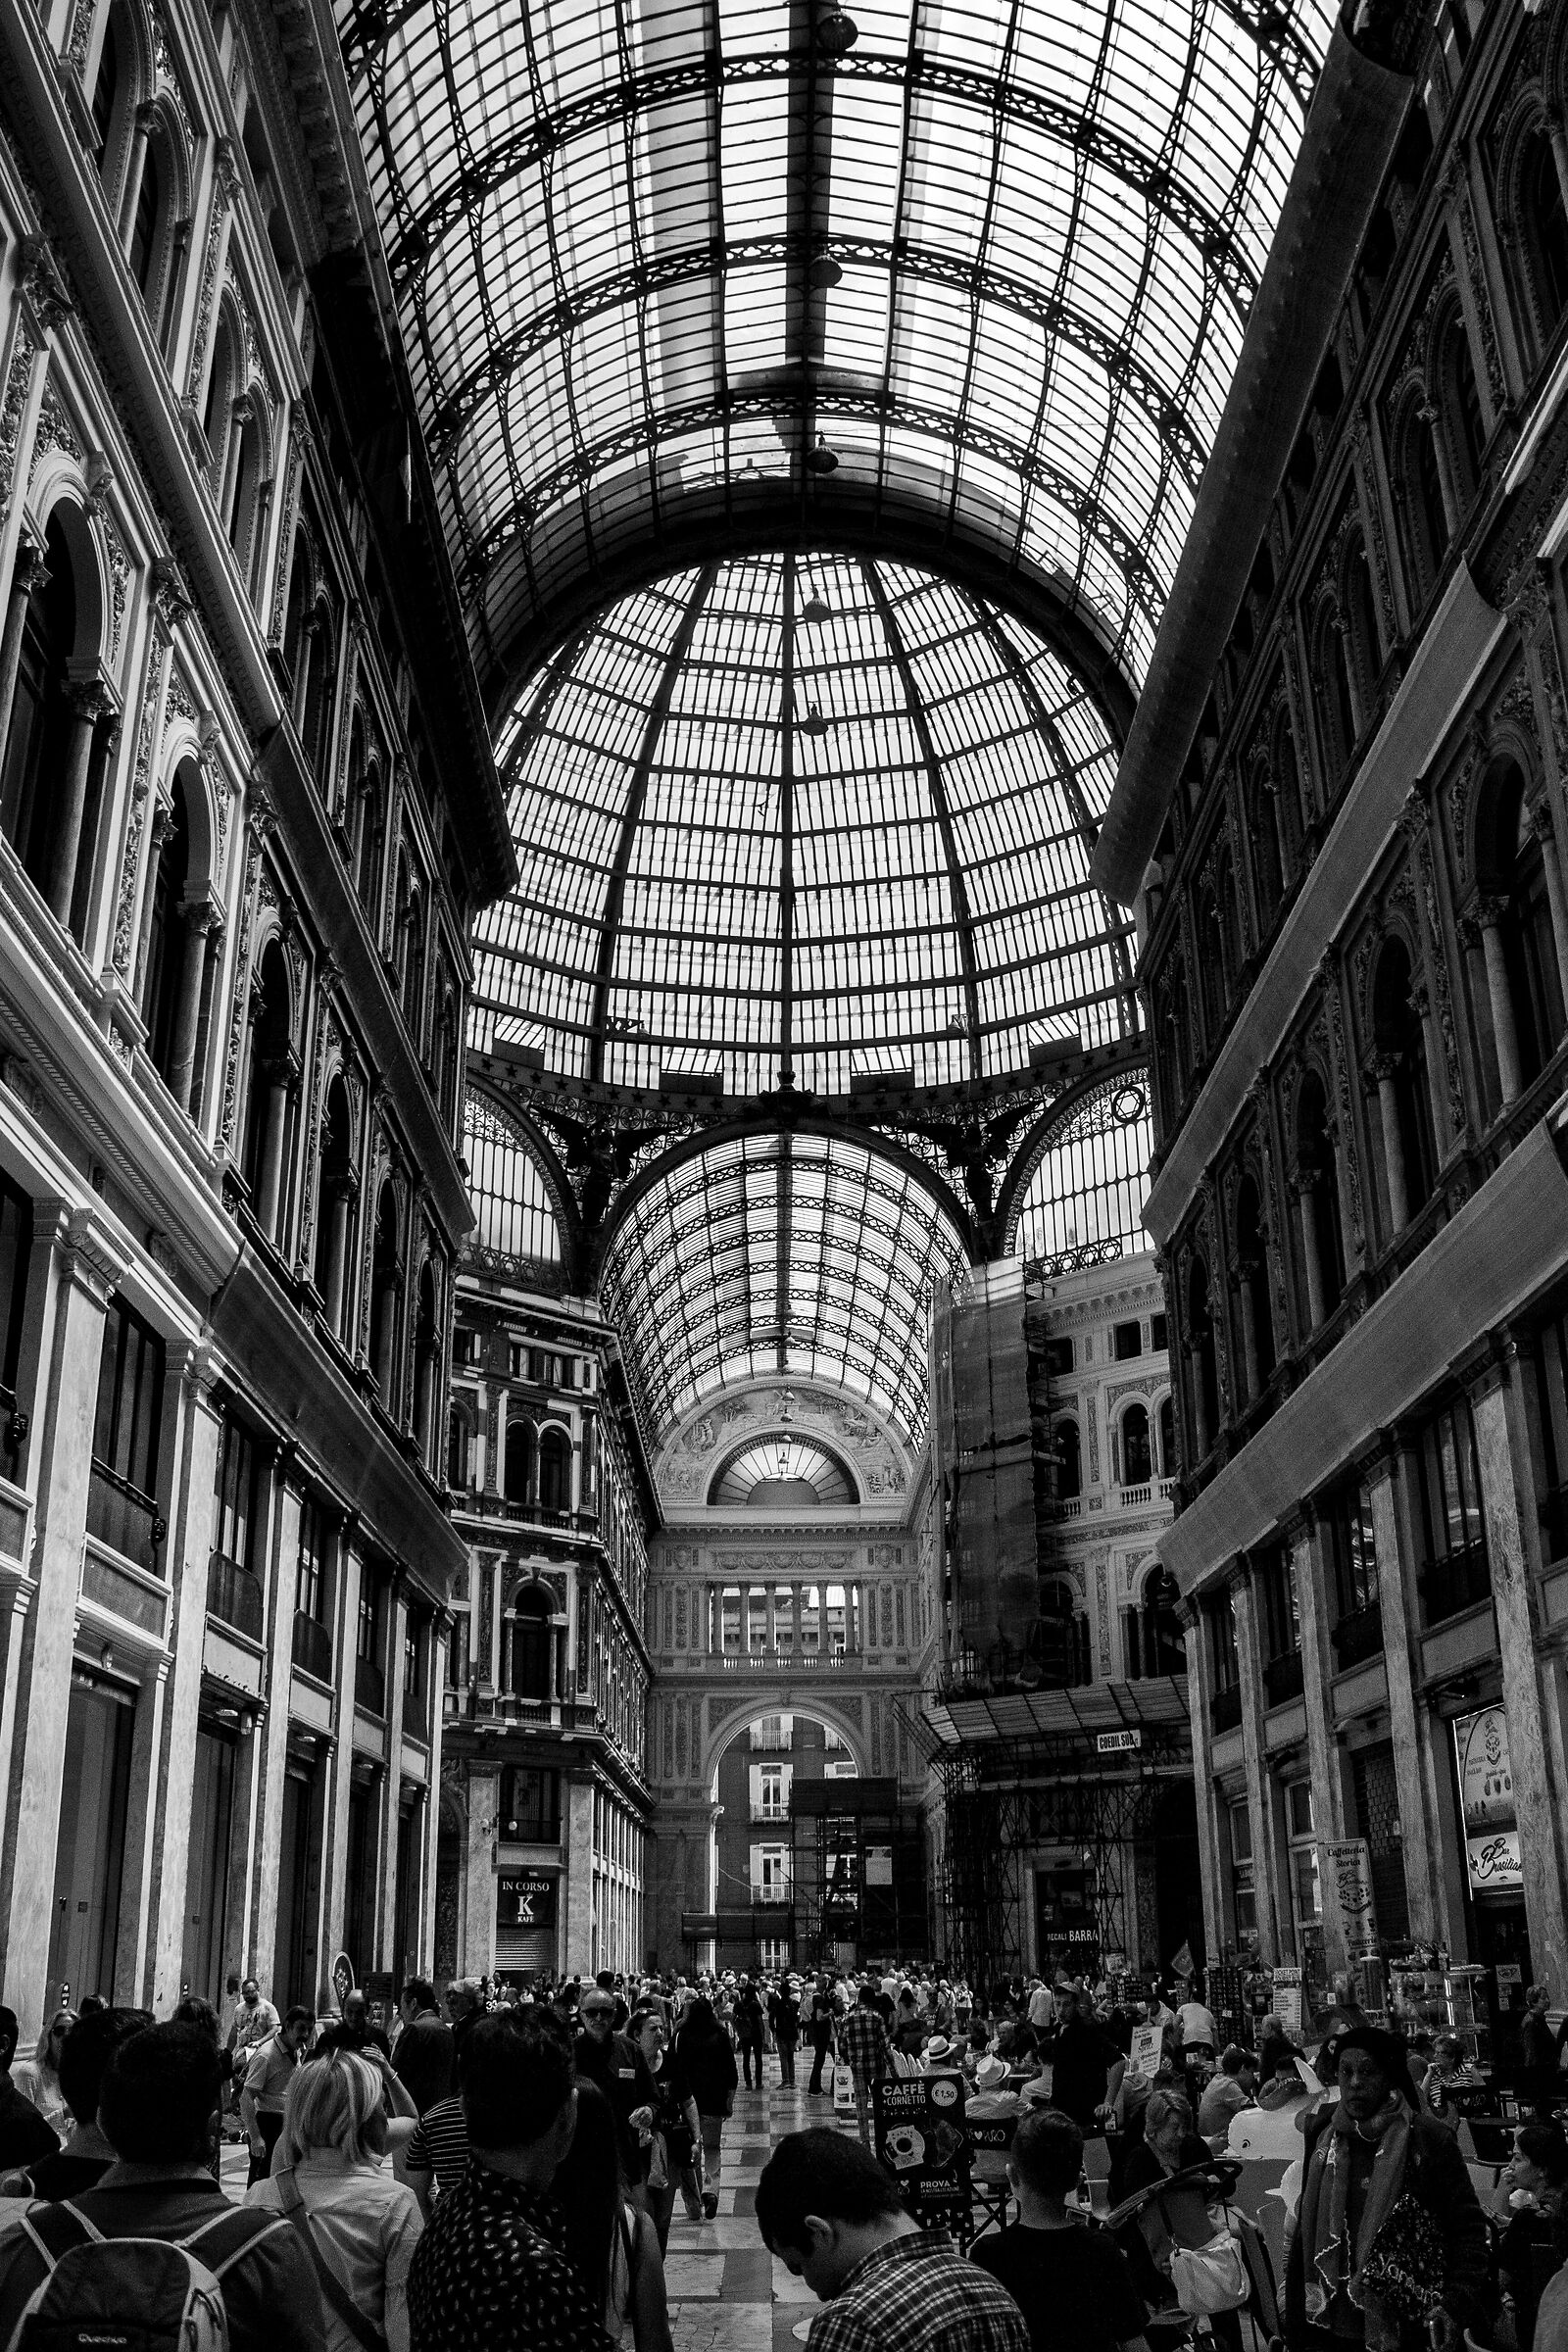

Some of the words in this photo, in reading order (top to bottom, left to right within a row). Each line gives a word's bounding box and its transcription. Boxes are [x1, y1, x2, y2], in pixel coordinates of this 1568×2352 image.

[1328, 1846, 1365, 1858] Caffetteria
[1336, 1858, 1360, 1867] Storica
[502, 1882, 514, 1890] IN
[515, 1882, 550, 1891] CORSO
[517, 1895, 534, 1915] K
[1069, 1930, 1099, 1941] BARRA
[882, 2081, 925, 2095] CAFFÈ
[920, 2180, 951, 2188] PROVA
